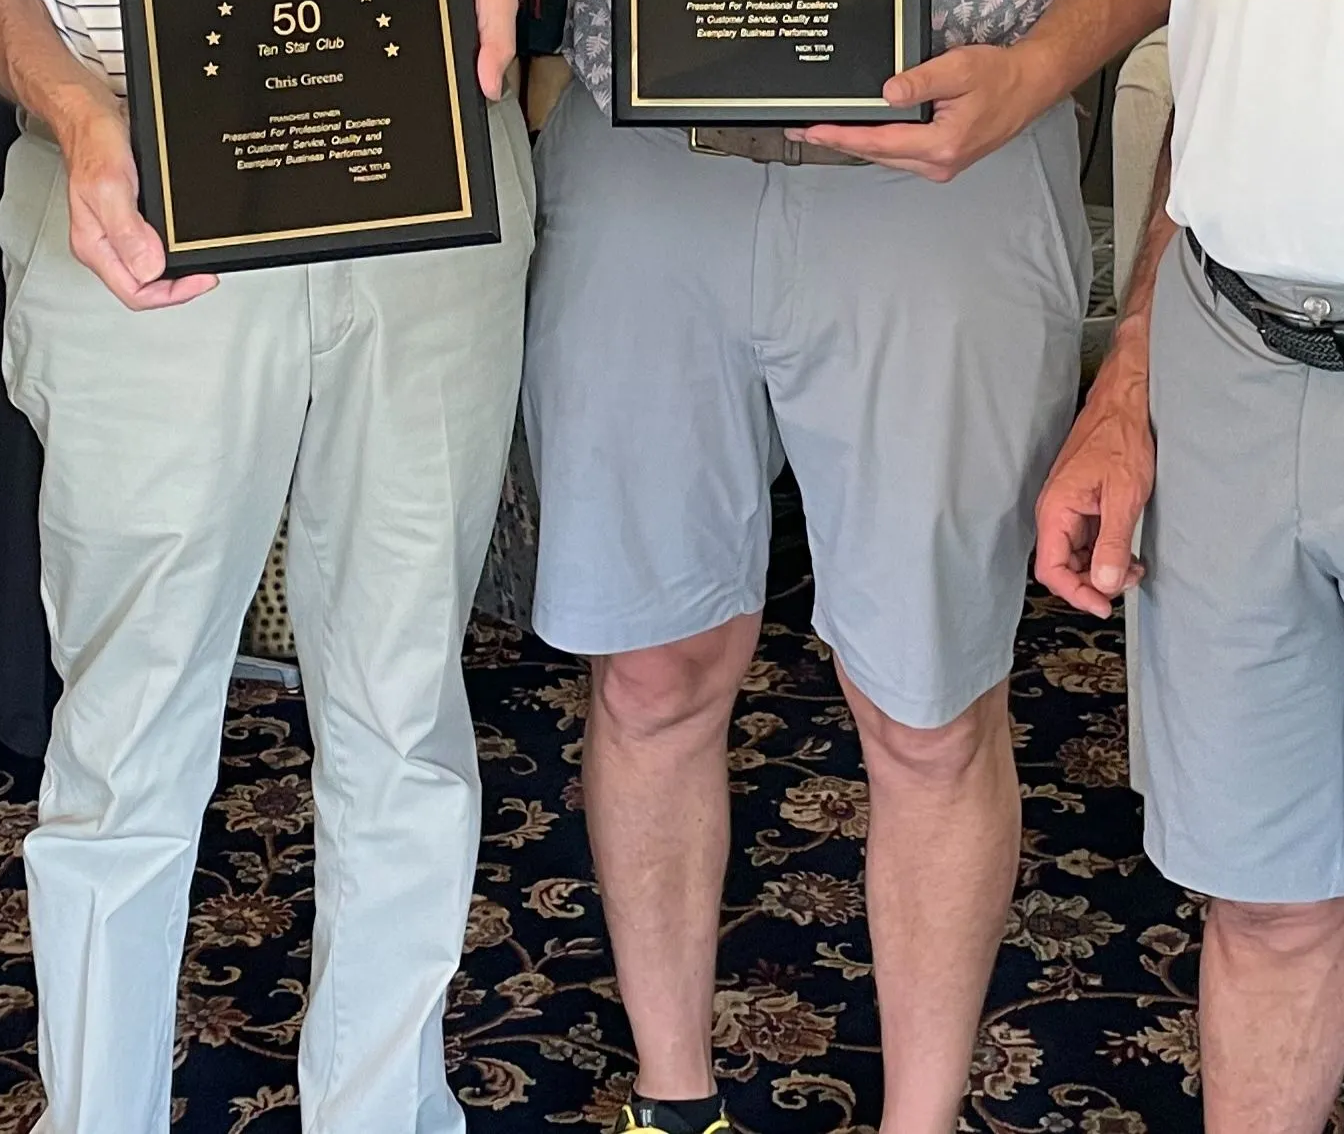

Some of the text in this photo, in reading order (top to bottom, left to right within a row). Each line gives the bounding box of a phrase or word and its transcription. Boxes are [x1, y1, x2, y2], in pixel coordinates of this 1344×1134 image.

[728, 1, 743, 11] For
[273, 0, 321, 36] 50
[781, 14, 811, 25] Quality
[812, 14, 830, 24] and
[258, 37, 344, 56] Ten Star Club
[266, 74, 343, 89] Chris Greene
[269, 128, 286, 137] For
[330, 135, 362, 145] Quality
[365, 131, 382, 141] and
